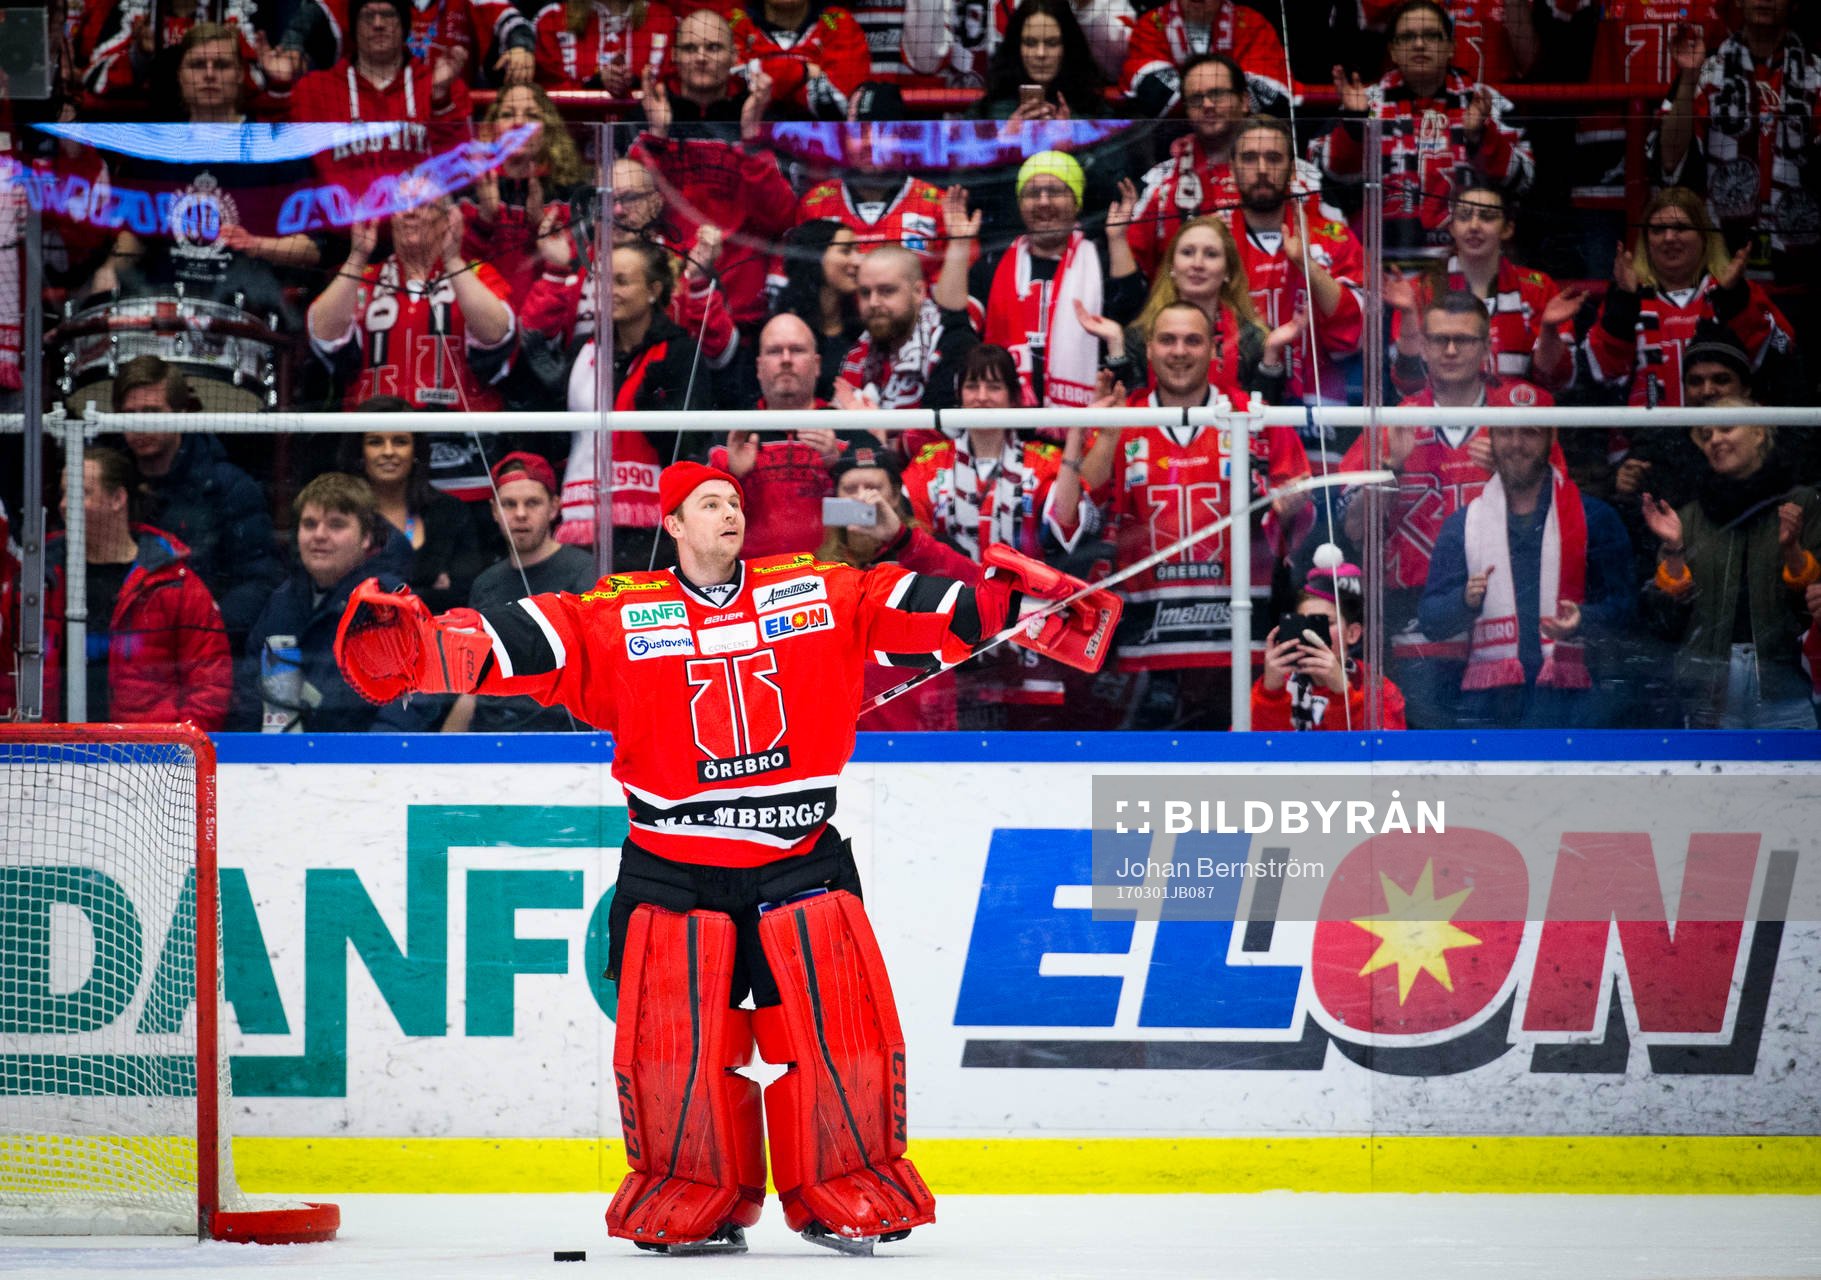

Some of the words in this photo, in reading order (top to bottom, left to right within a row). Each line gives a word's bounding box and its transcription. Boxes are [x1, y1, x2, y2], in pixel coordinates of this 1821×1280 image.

[612, 465, 655, 488] 990
[704, 585, 729, 594] SHL
[628, 603, 686, 627] DANFO
[704, 612, 744, 625] BAUER
[765, 607, 828, 638] ELON
[708, 640, 749, 652] CONCENT
[704, 752, 785, 779] ÖREBRO
[953, 827, 1770, 1045] ELON
[892, 1050, 905, 1150] CCM
[615, 1071, 641, 1160] CCM
